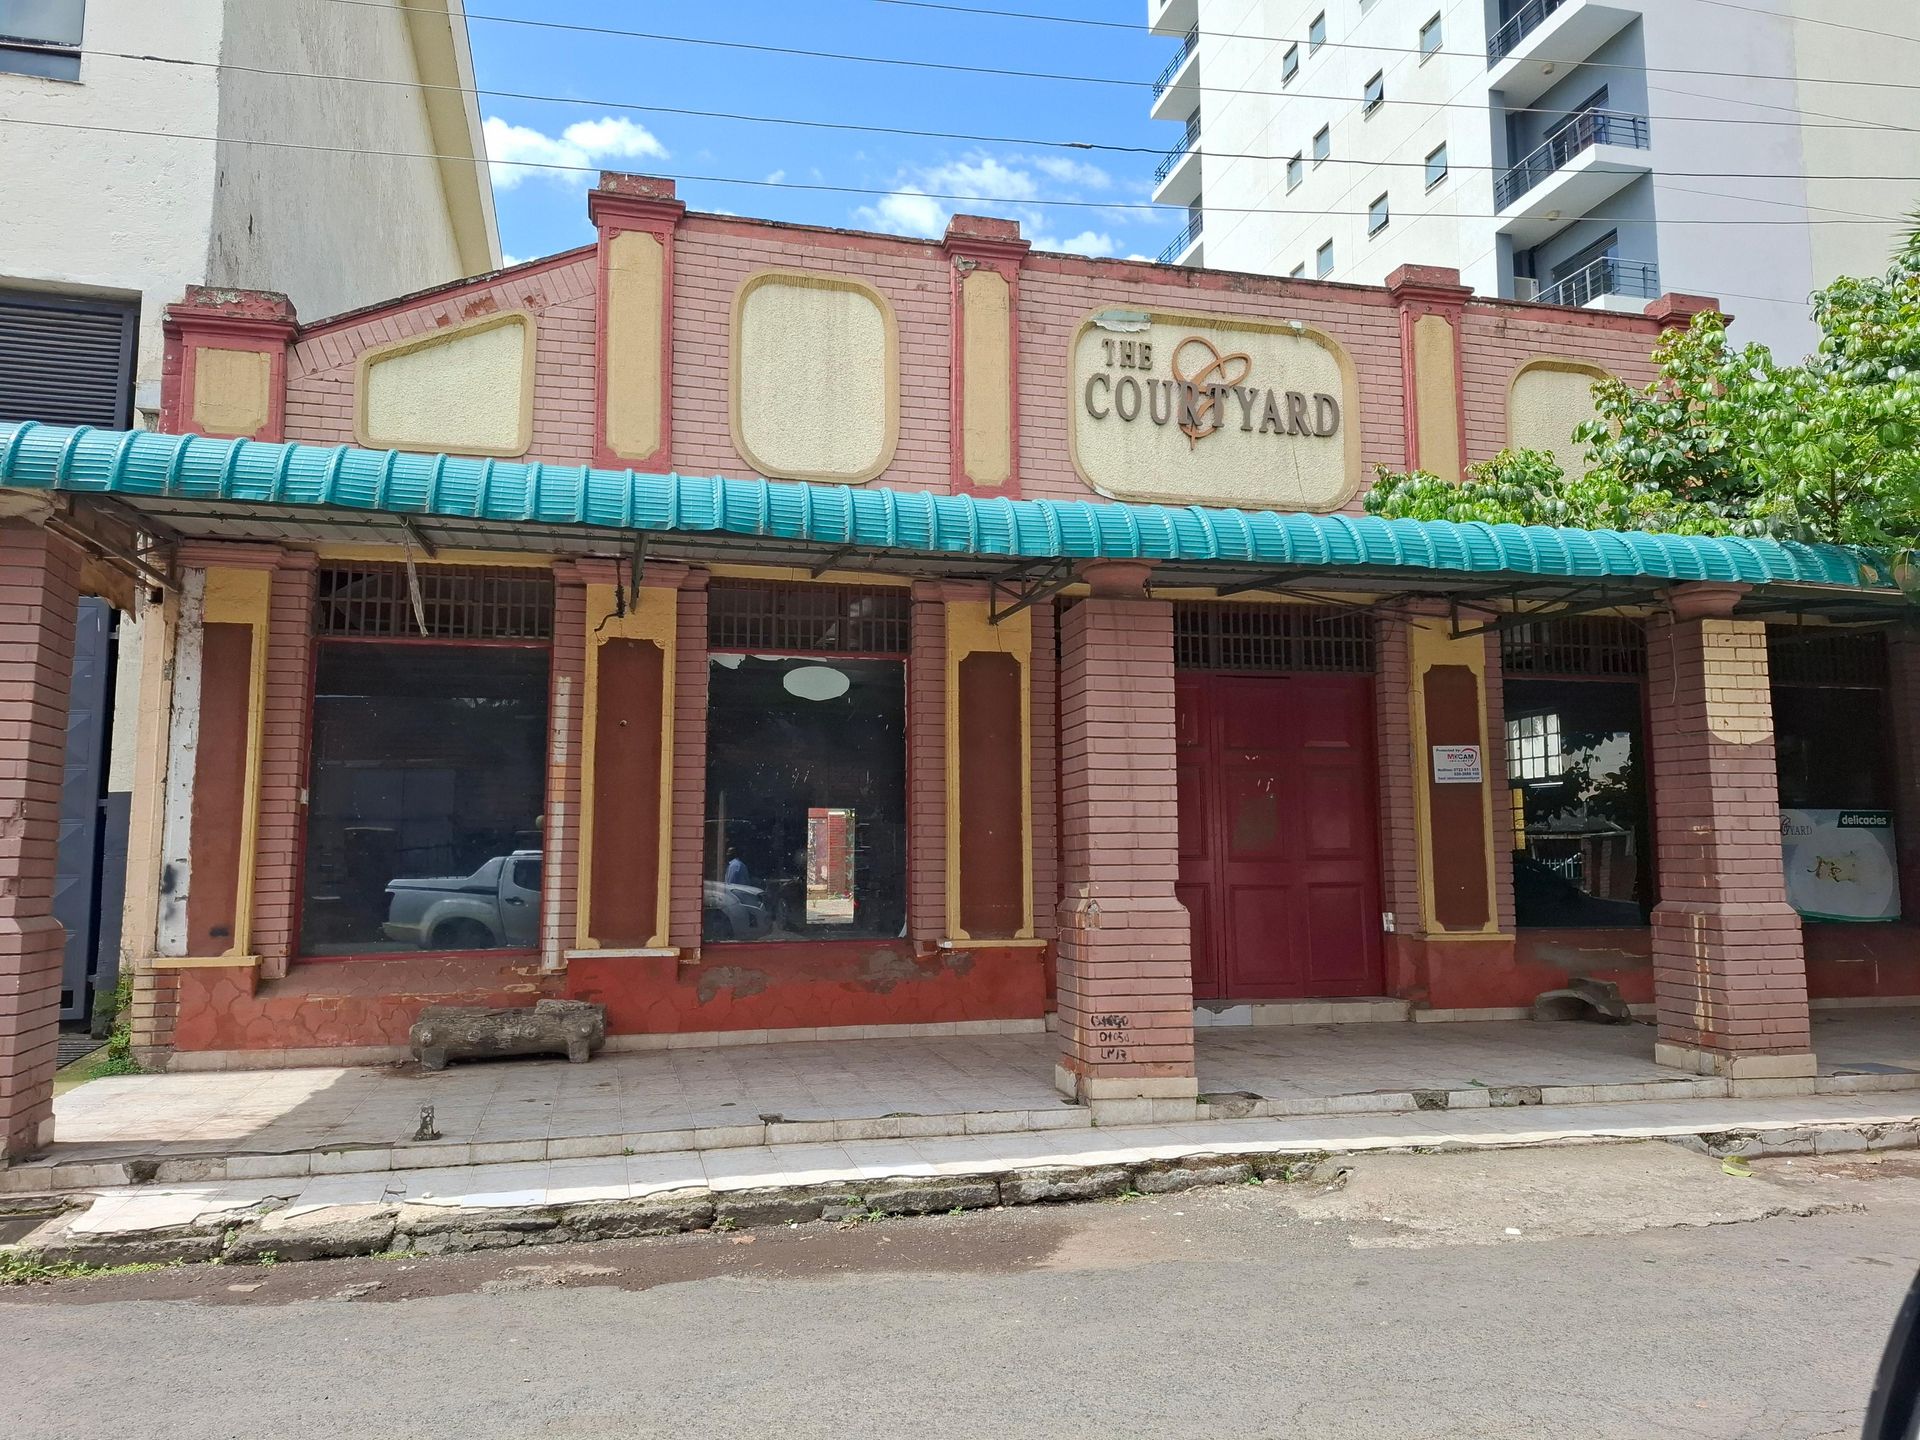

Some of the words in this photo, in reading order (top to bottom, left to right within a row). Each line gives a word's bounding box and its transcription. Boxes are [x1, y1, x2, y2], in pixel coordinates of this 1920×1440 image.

[1101, 338, 1153, 370] THE
[1085, 372, 1340, 437] COURTYARD
[1841, 815, 1887, 825] delicacies
